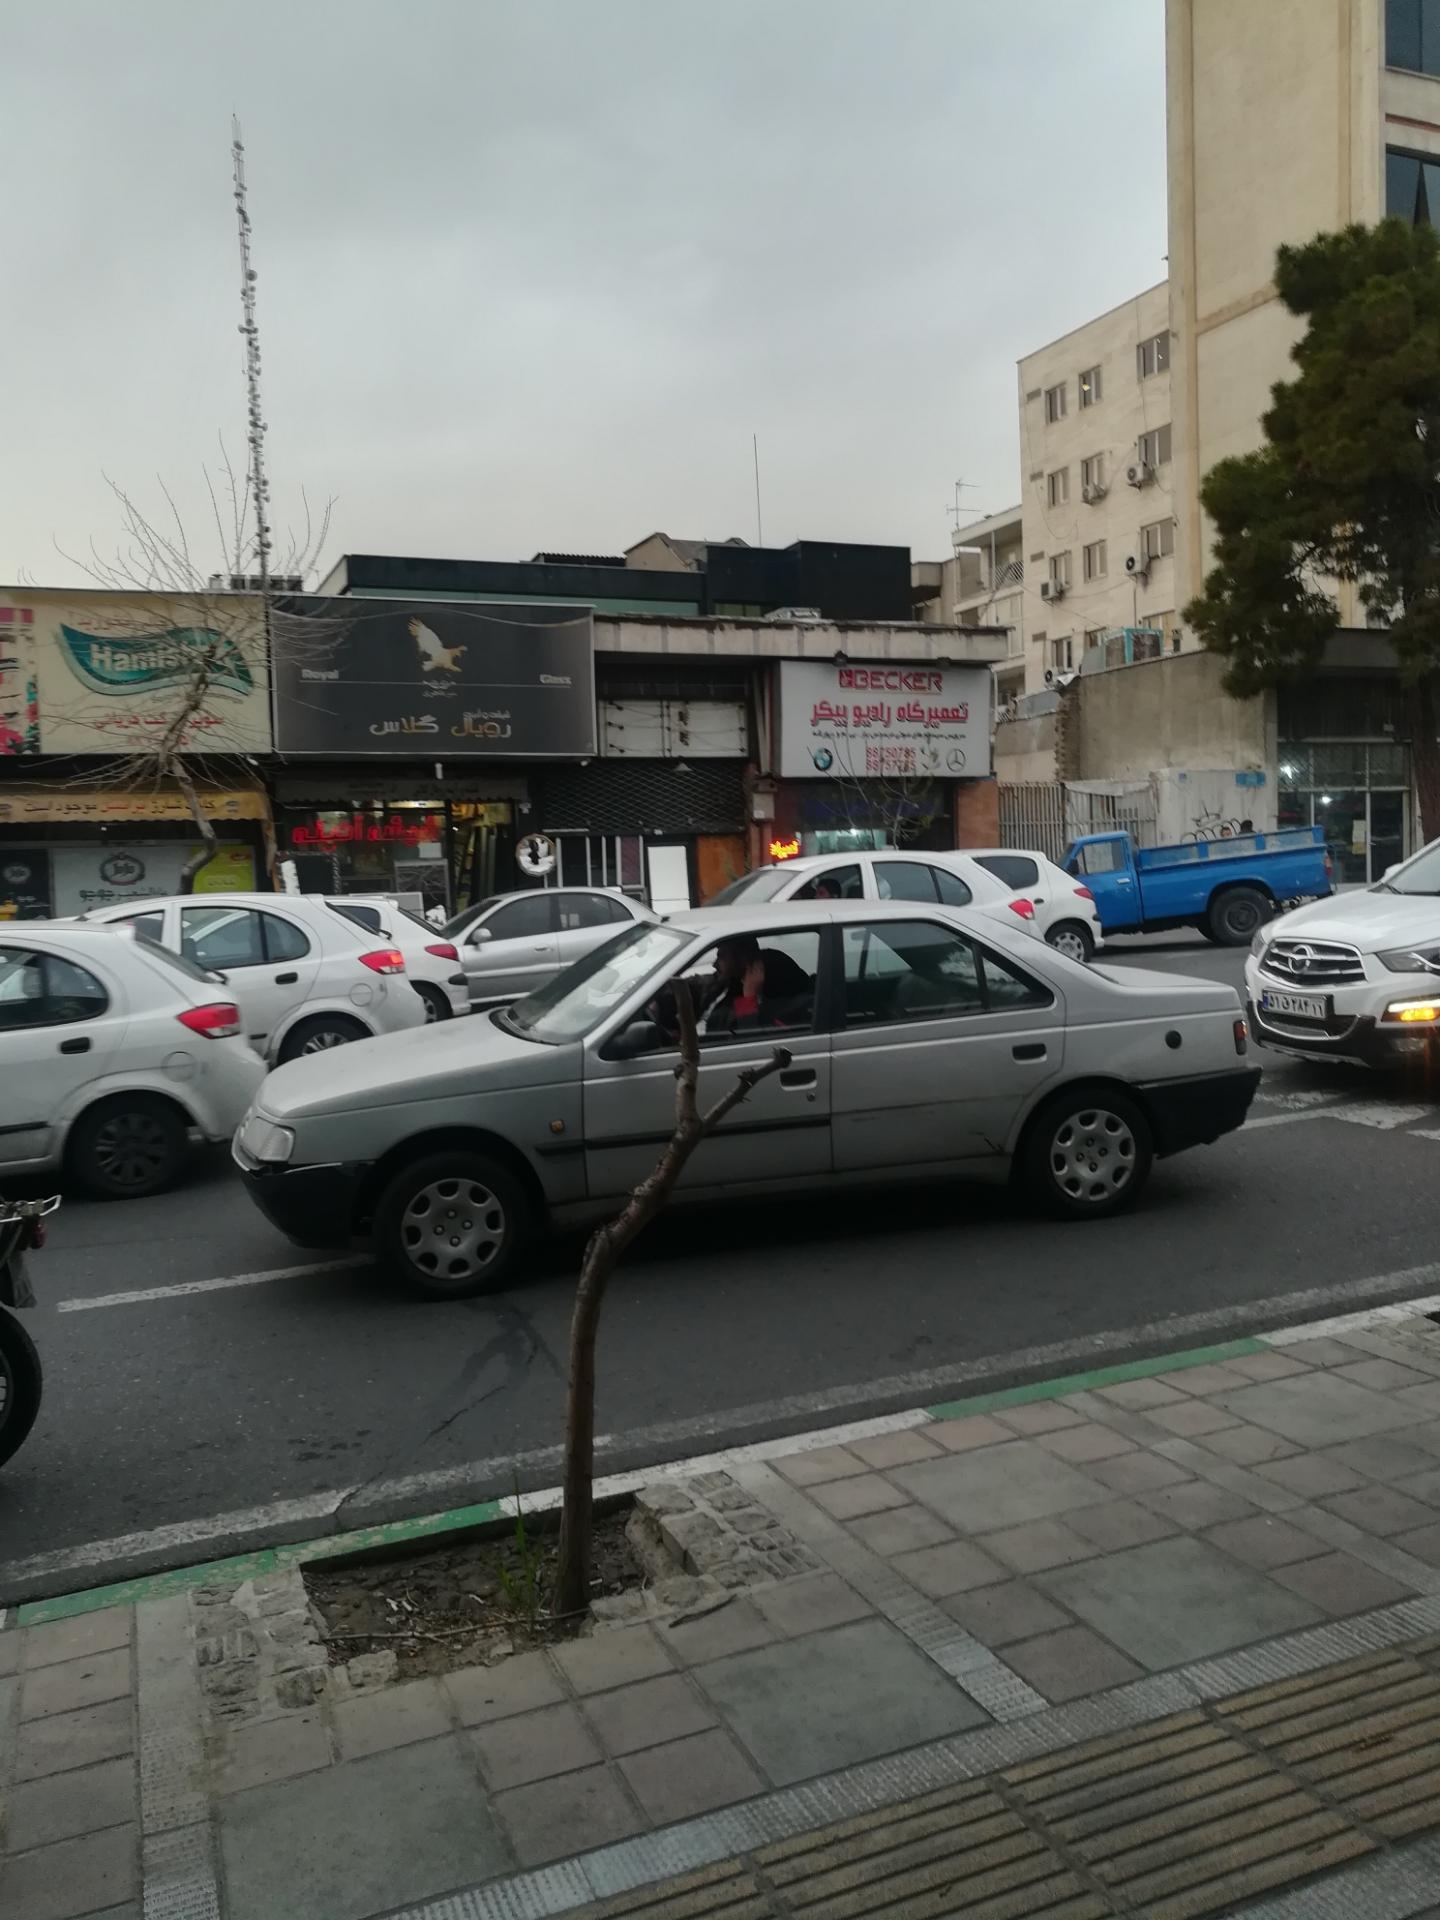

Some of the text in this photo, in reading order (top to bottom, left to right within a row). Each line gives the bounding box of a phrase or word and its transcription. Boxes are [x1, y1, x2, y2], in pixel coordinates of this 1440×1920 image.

[301, 669, 339, 681] Royal
[853, 669, 943, 692] BECKER
[369, 714, 512, 739] رویال گلاس
[853, 702, 892, 728] رادیو
[896, 702, 969, 729] تعمیرگاه
